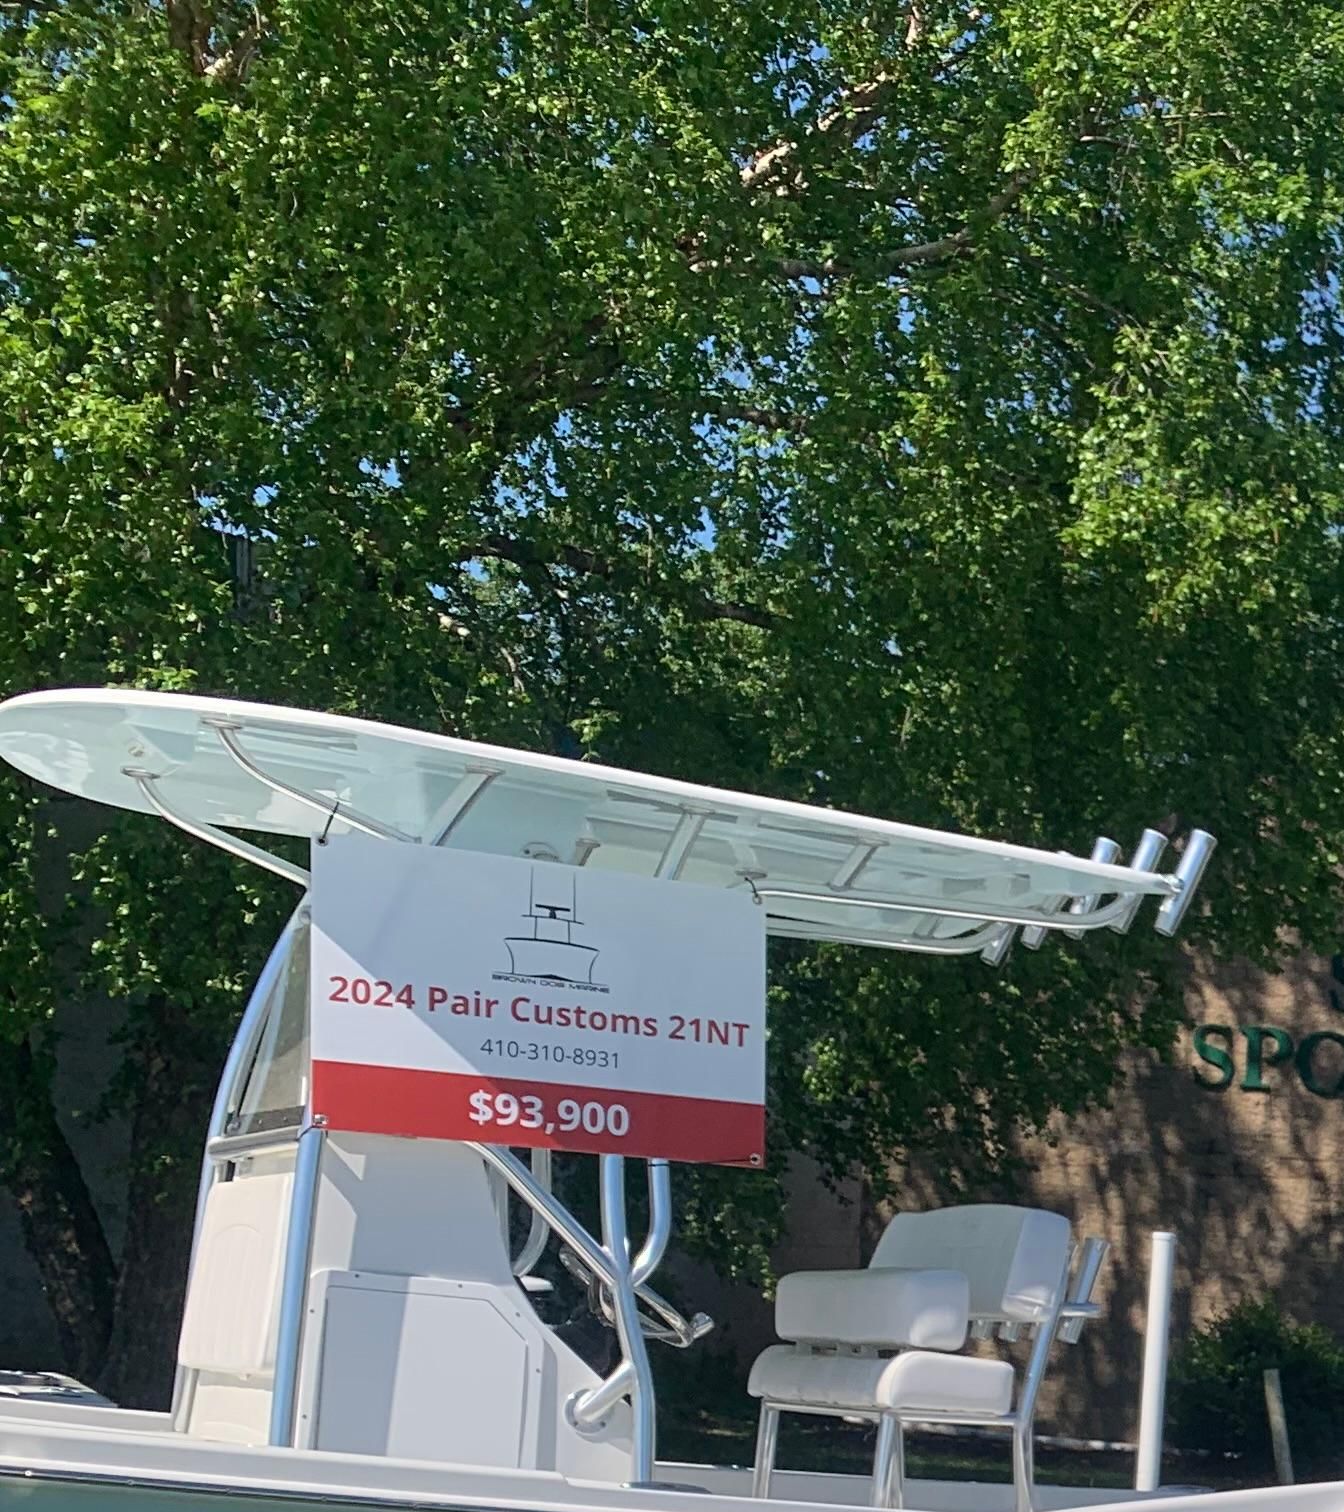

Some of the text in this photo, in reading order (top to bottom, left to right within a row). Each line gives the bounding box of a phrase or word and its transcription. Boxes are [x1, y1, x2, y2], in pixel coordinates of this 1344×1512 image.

[329, 976, 750, 1047] 2024 Pair Customs 21NT
[480, 1038, 620, 1069] 410-310-8931
[468, 1089, 630, 1137] $93,900
